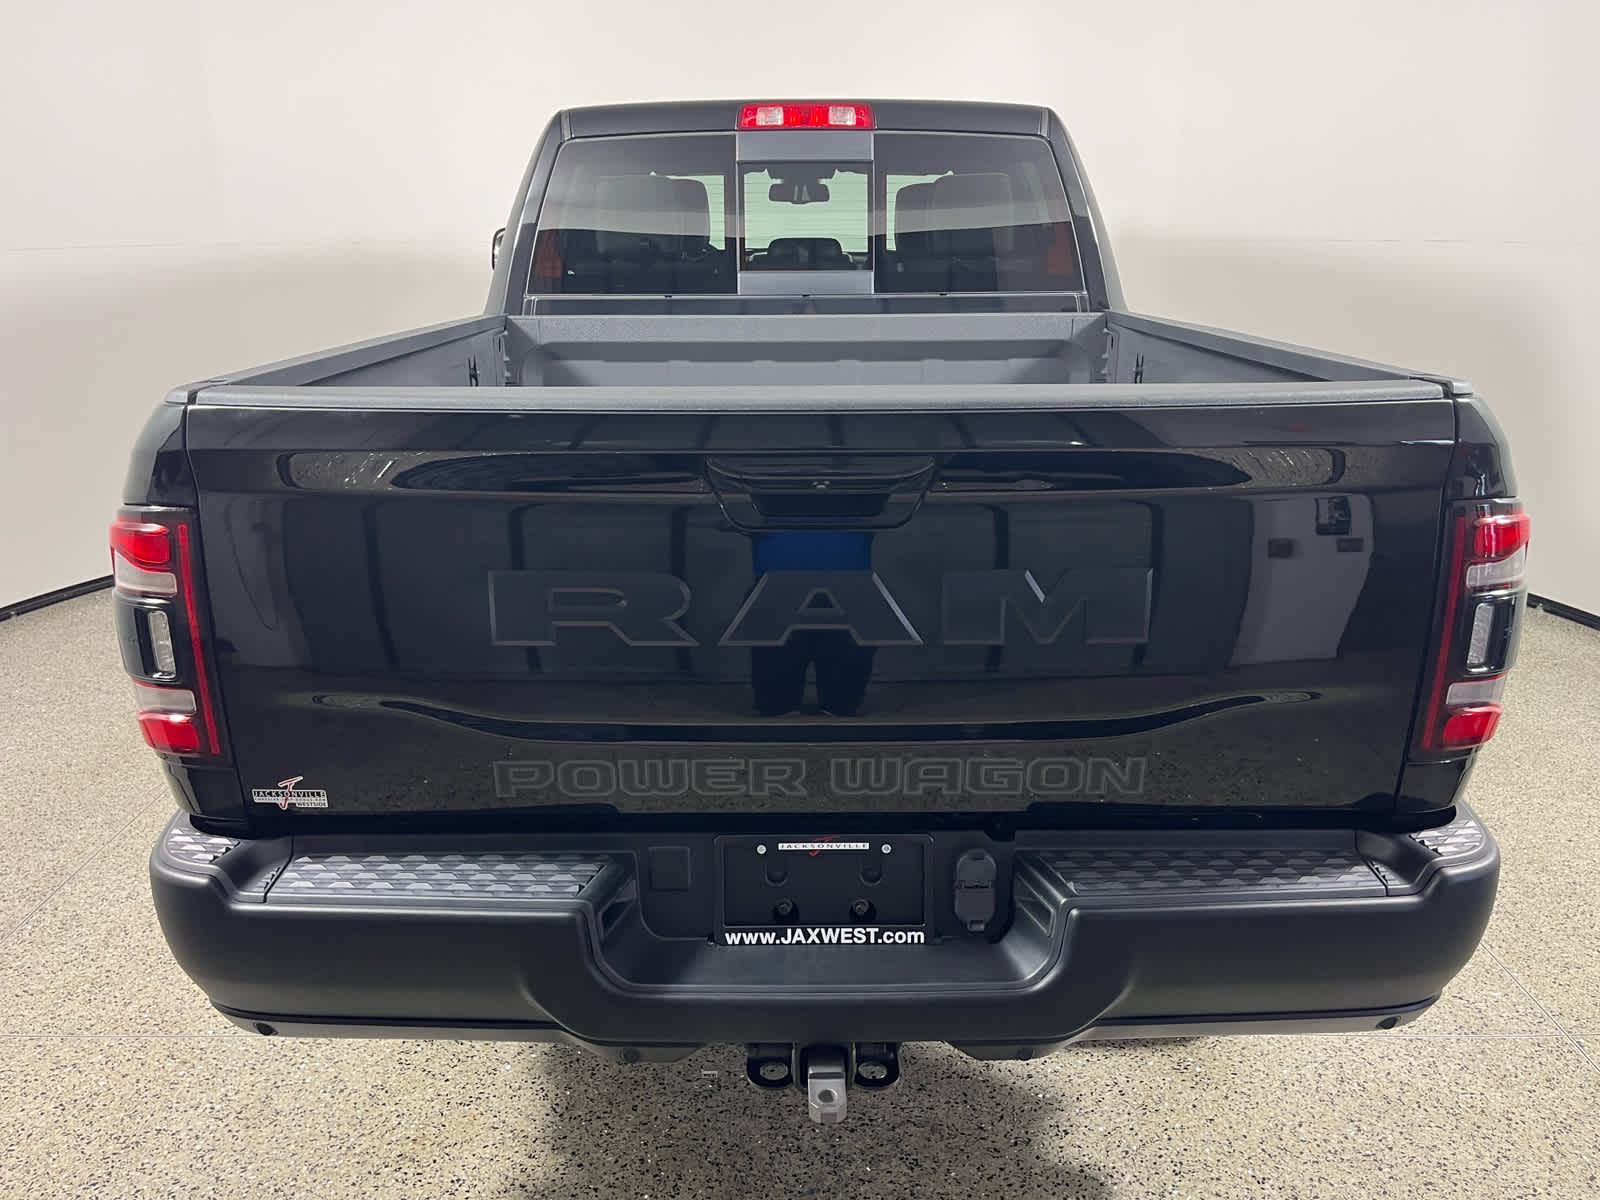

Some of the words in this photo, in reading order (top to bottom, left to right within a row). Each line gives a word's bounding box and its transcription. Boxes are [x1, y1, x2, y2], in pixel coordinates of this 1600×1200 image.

[487, 569, 1154, 648] RAM
[493, 757, 809, 798] POWER
[830, 756, 1148, 797] WAGON
[725, 928, 925, 944] www.JAXWEST.com
